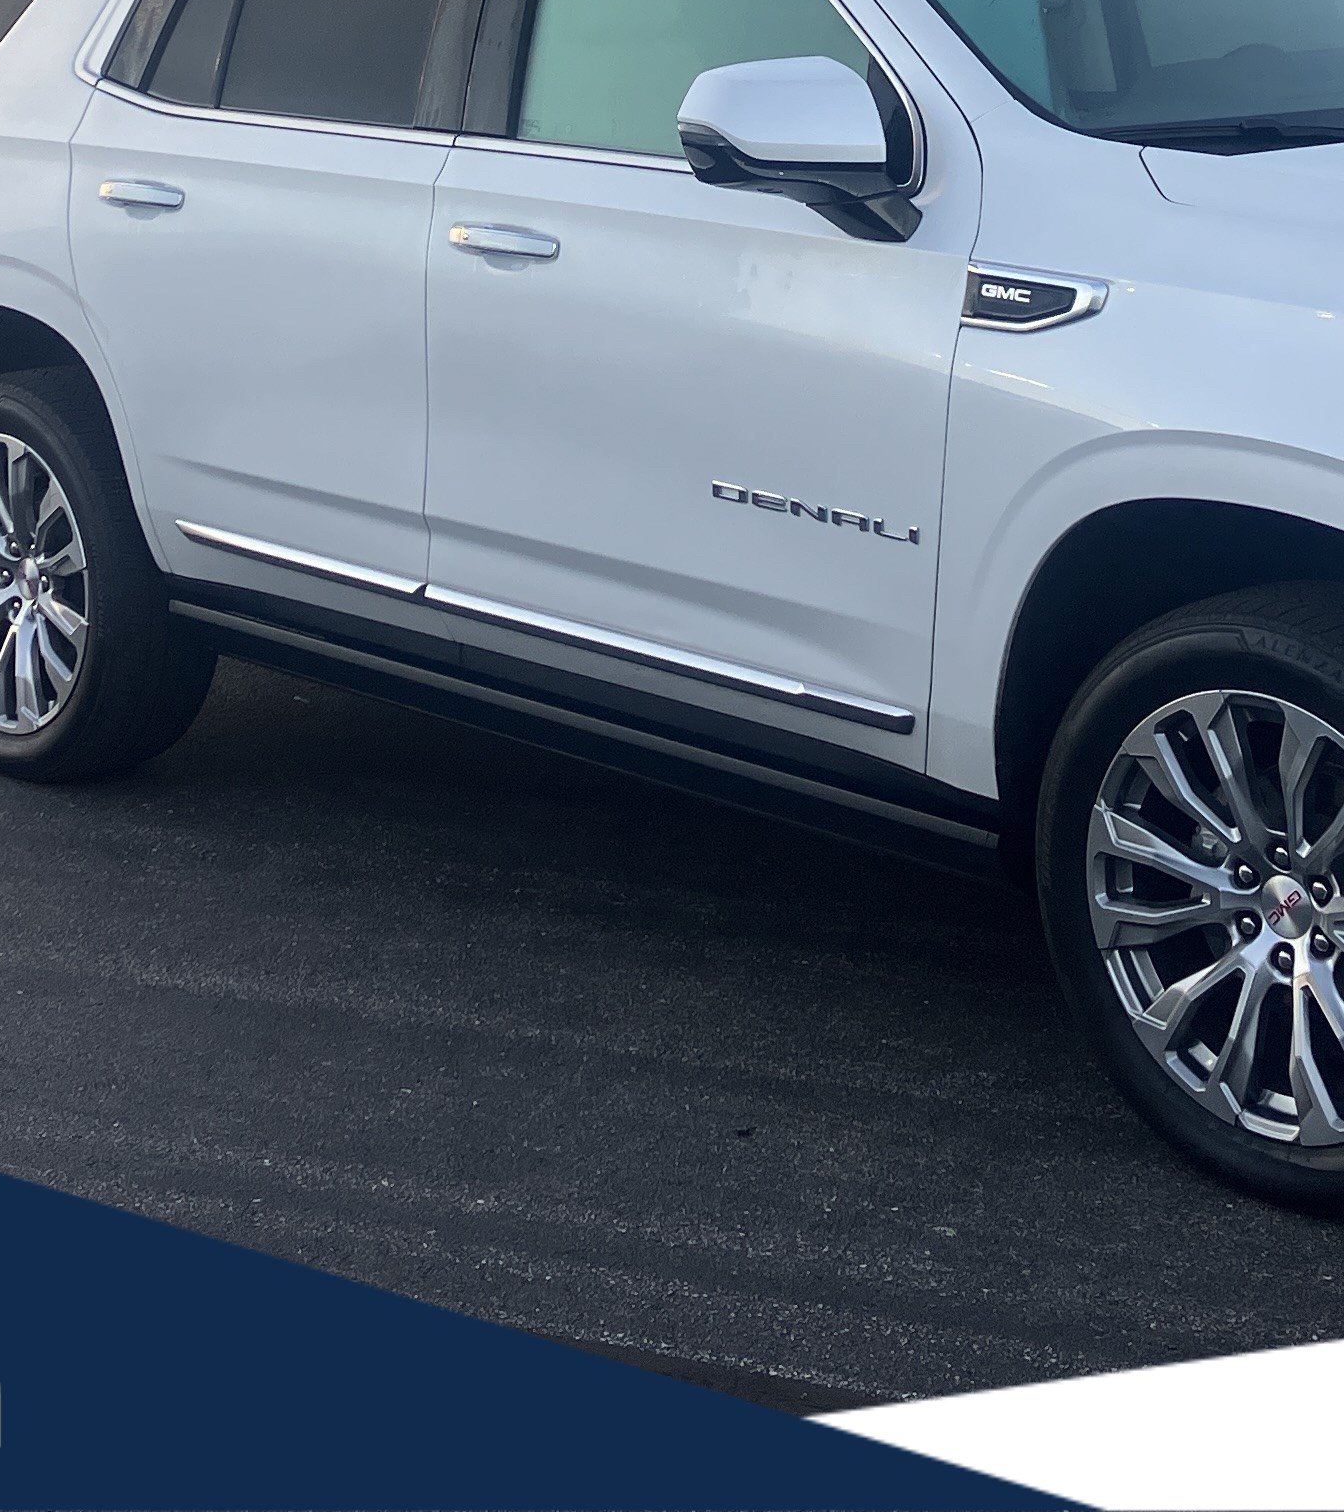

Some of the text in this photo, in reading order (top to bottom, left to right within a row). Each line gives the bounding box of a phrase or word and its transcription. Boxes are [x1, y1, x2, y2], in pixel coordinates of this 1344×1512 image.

[981, 283, 1031, 303] GMC
[1252, 635, 1343, 683] ALENZA
[1267, 890, 1302, 926] GMC
